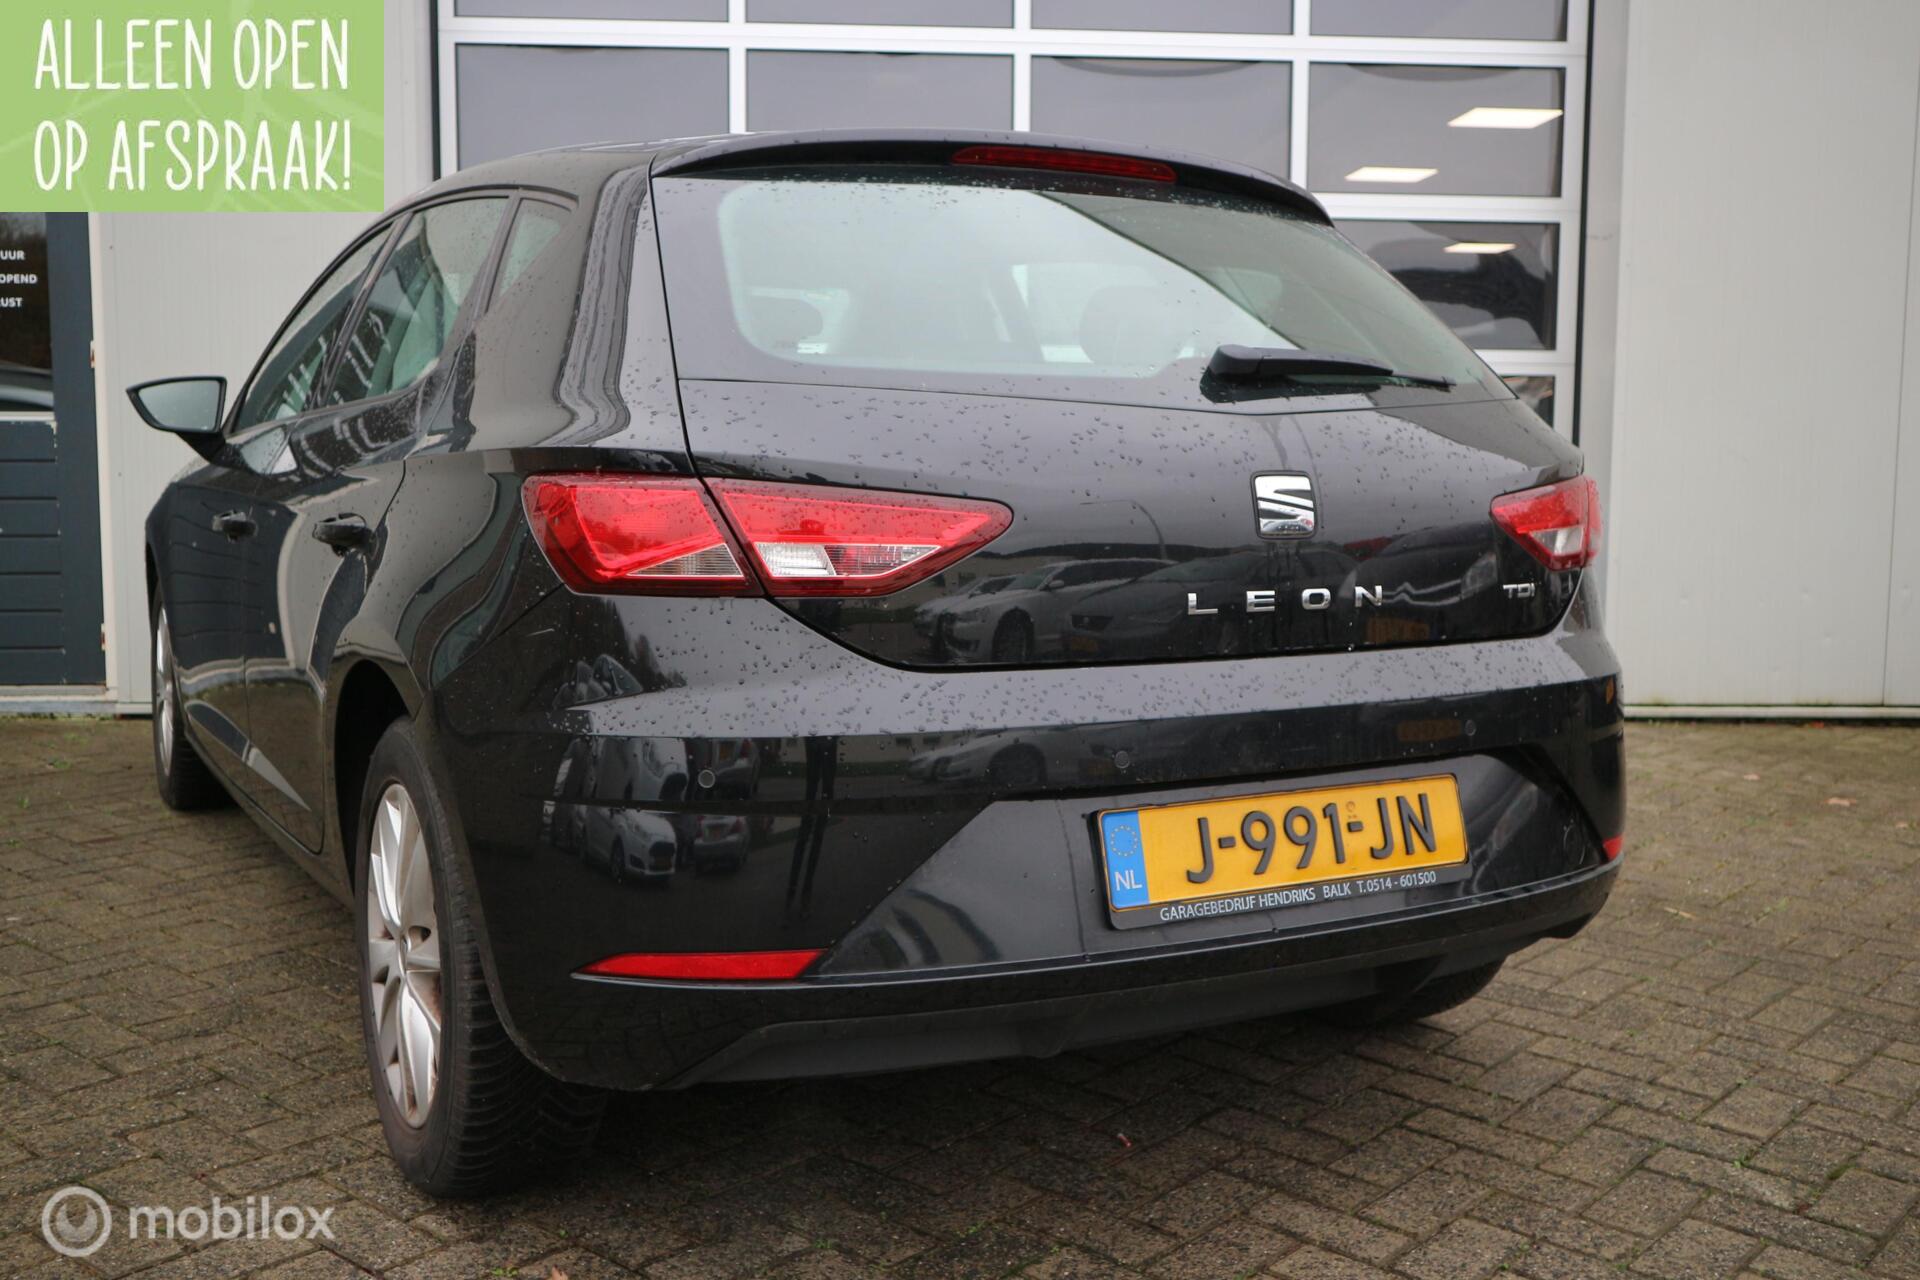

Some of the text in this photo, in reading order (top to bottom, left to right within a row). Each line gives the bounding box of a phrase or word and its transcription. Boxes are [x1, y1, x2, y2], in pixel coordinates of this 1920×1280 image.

[1187, 585, 1384, 615] LEON
[1186, 793, 1437, 884] J-991-JN
[1114, 869, 1143, 891] NL
[1160, 895, 1257, 921] GARAGEBEDRIJF
[1259, 887, 1316, 908] HENDRIKS
[1323, 882, 1352, 899] BALK
[1400, 871, 1437, 888] 601500
